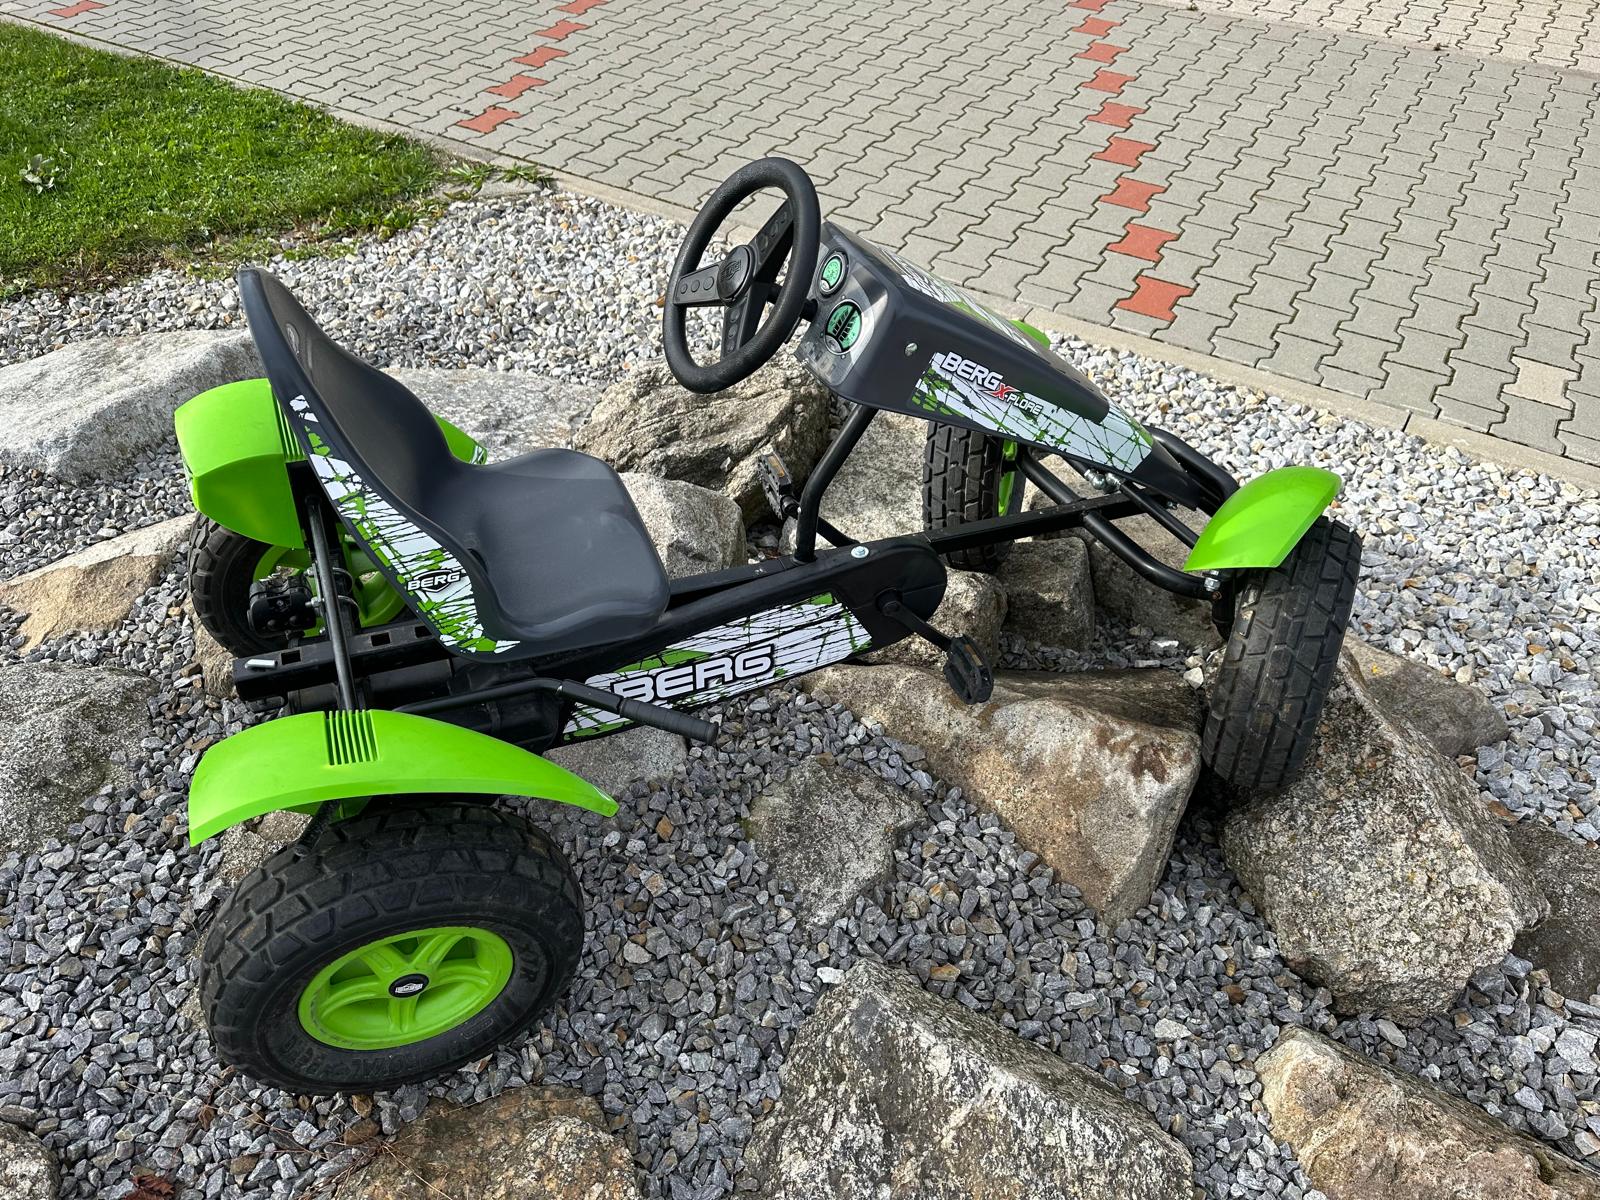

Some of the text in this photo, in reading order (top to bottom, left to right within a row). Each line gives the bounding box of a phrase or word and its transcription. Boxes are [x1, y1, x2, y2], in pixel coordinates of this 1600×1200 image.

[940, 351, 1003, 391] BERG
[407, 572, 461, 591] BERG
[611, 648, 774, 703] BERG
